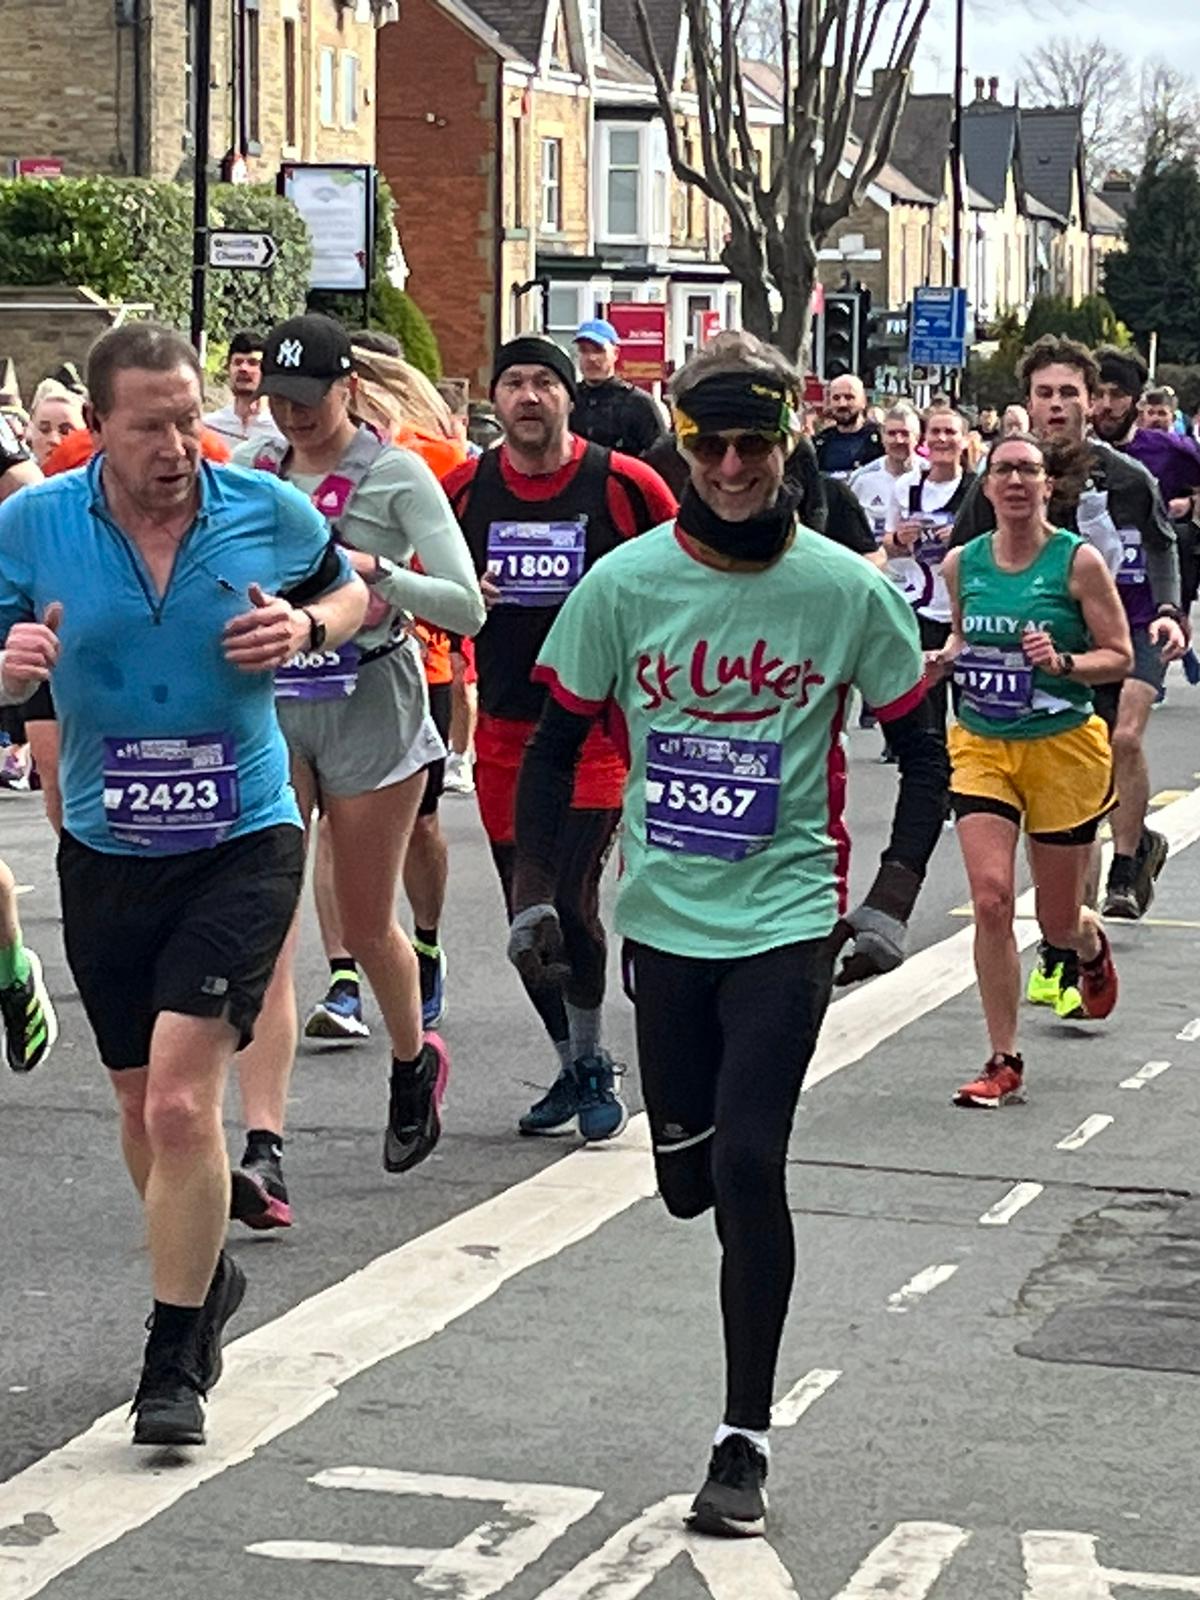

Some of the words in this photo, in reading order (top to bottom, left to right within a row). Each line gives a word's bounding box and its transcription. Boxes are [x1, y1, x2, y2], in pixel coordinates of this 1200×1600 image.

[276, 338, 304, 367] NY
[507, 554, 570, 577] 1800
[636, 651, 684, 710] St
[688, 638, 826, 709] Luke's
[968, 670, 1017, 693] 1711
[127, 779, 219, 812] 2423
[667, 779, 757, 818] 5367
